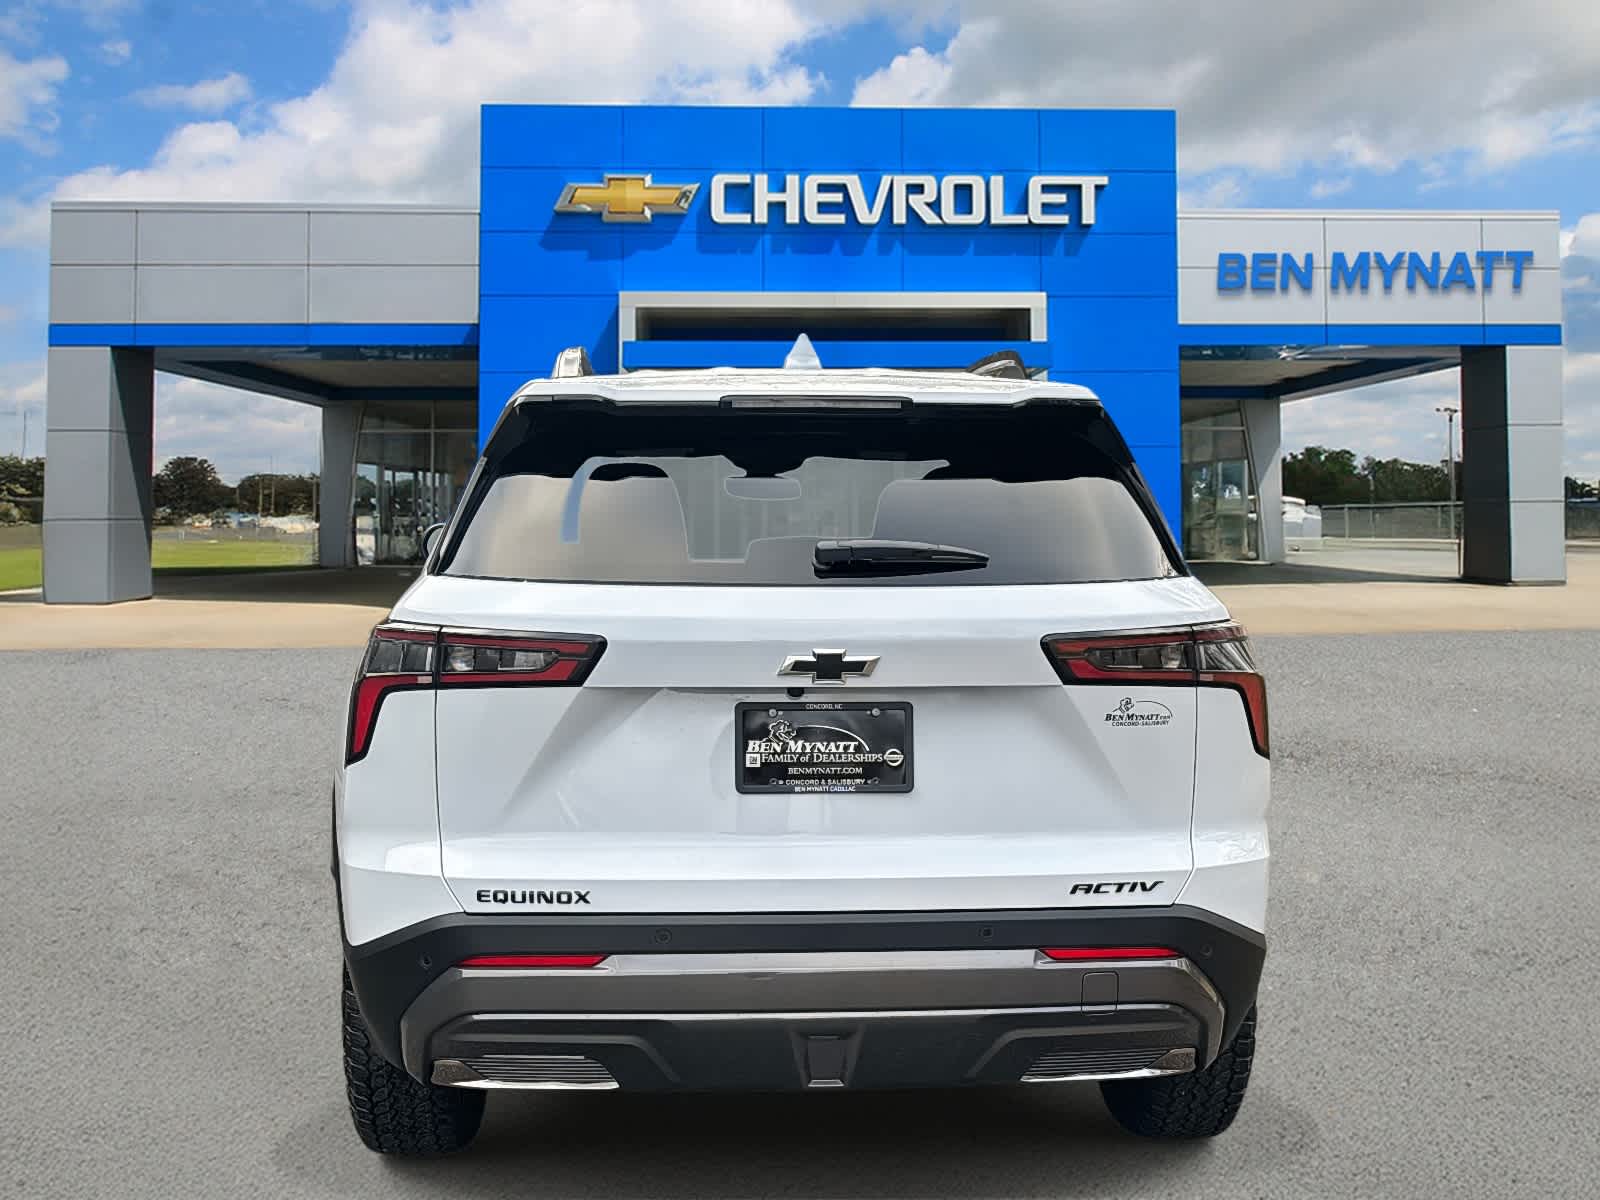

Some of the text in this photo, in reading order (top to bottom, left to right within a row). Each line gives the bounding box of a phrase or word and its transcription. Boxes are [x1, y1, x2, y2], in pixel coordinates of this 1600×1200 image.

[709, 173, 1109, 226] CHEVROLET
[1217, 250, 1534, 291] BEN MYNATT
[1104, 713, 1124, 721] BEN
[746, 740, 859, 753] BEN MYNATT
[761, 752, 883, 763] FAMILY of DEALERSHIPS
[788, 767, 863, 775] BENMYNATT.COM
[1069, 881, 1165, 894] ACTIV
[476, 889, 592, 904] EQUINOX
